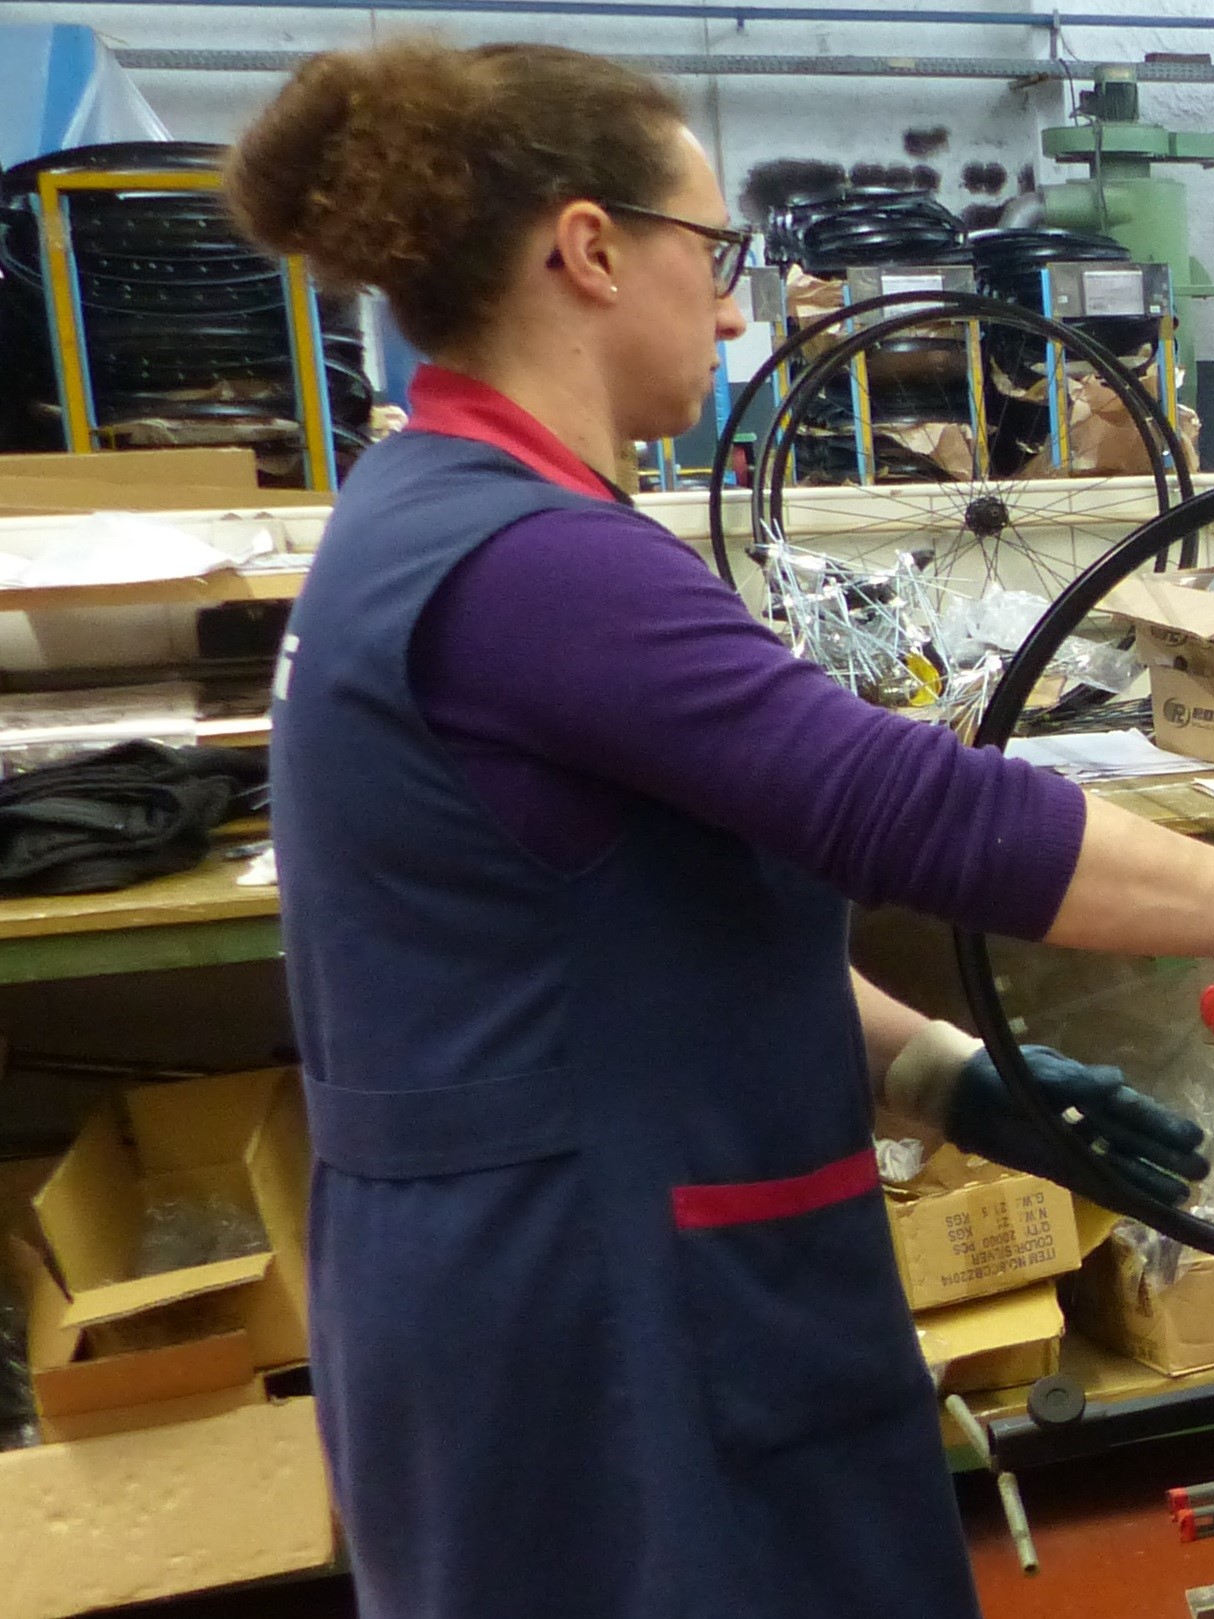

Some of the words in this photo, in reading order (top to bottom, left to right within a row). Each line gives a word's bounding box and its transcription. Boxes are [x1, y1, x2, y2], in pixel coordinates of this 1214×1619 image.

[945, 1212, 970, 1228] KGS
[948, 1226, 973, 1242] KGS
[1029, 1247, 1056, 1265] ITEM
